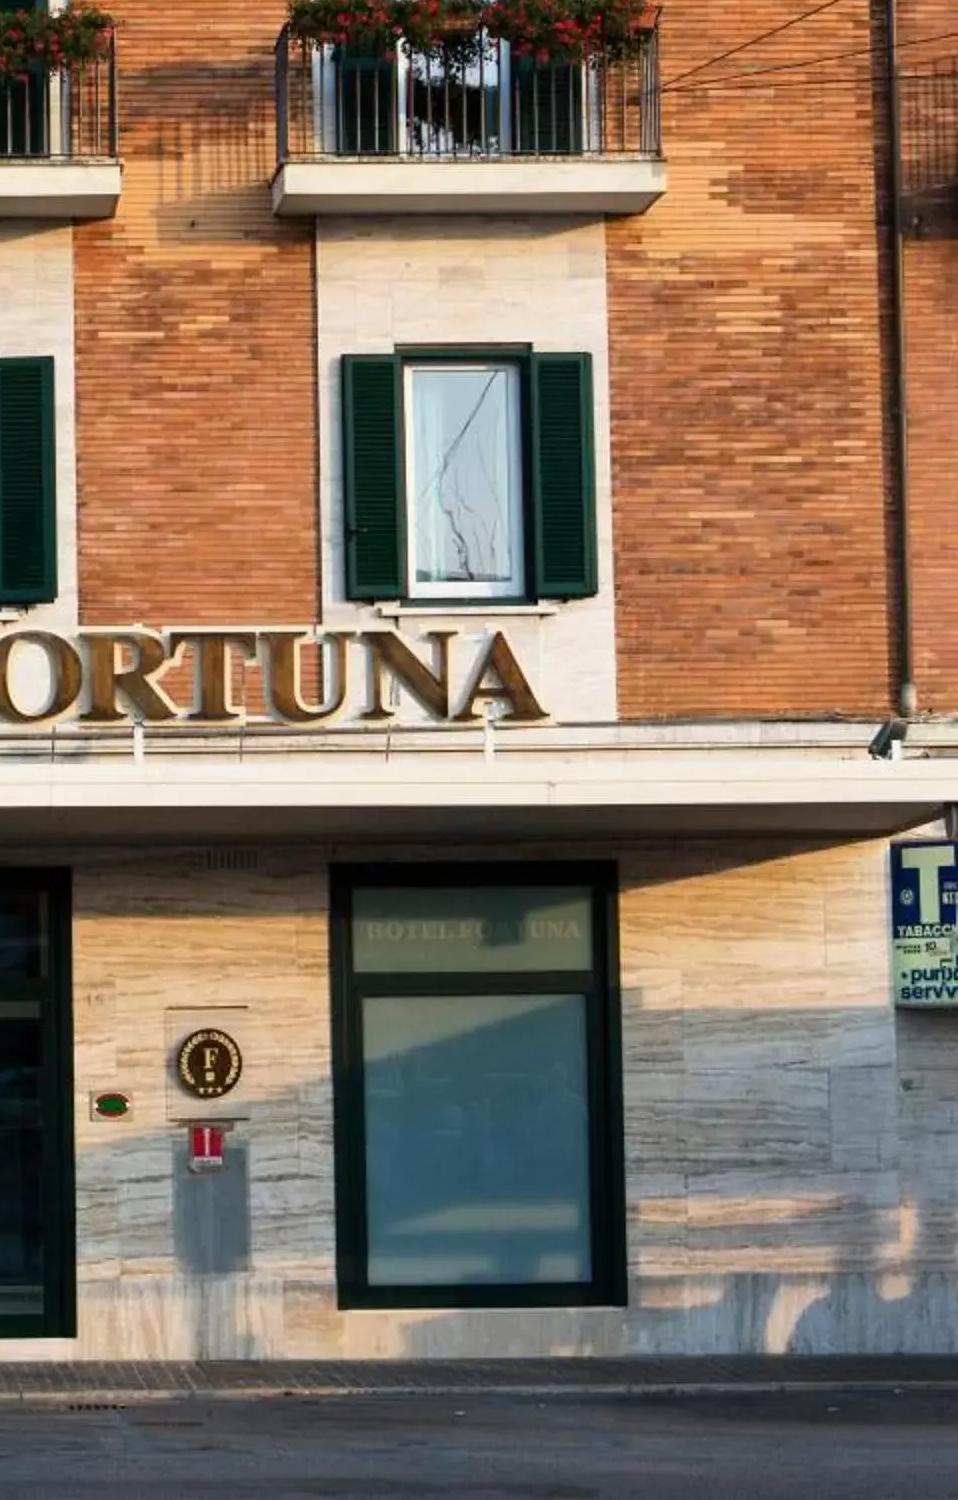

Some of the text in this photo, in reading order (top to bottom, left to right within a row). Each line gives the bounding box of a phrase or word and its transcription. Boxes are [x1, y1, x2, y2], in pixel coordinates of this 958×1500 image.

[901, 845, 955, 924] T
[459, 920, 581, 939] FOUNA
[203, 1047, 219, 1069] F
